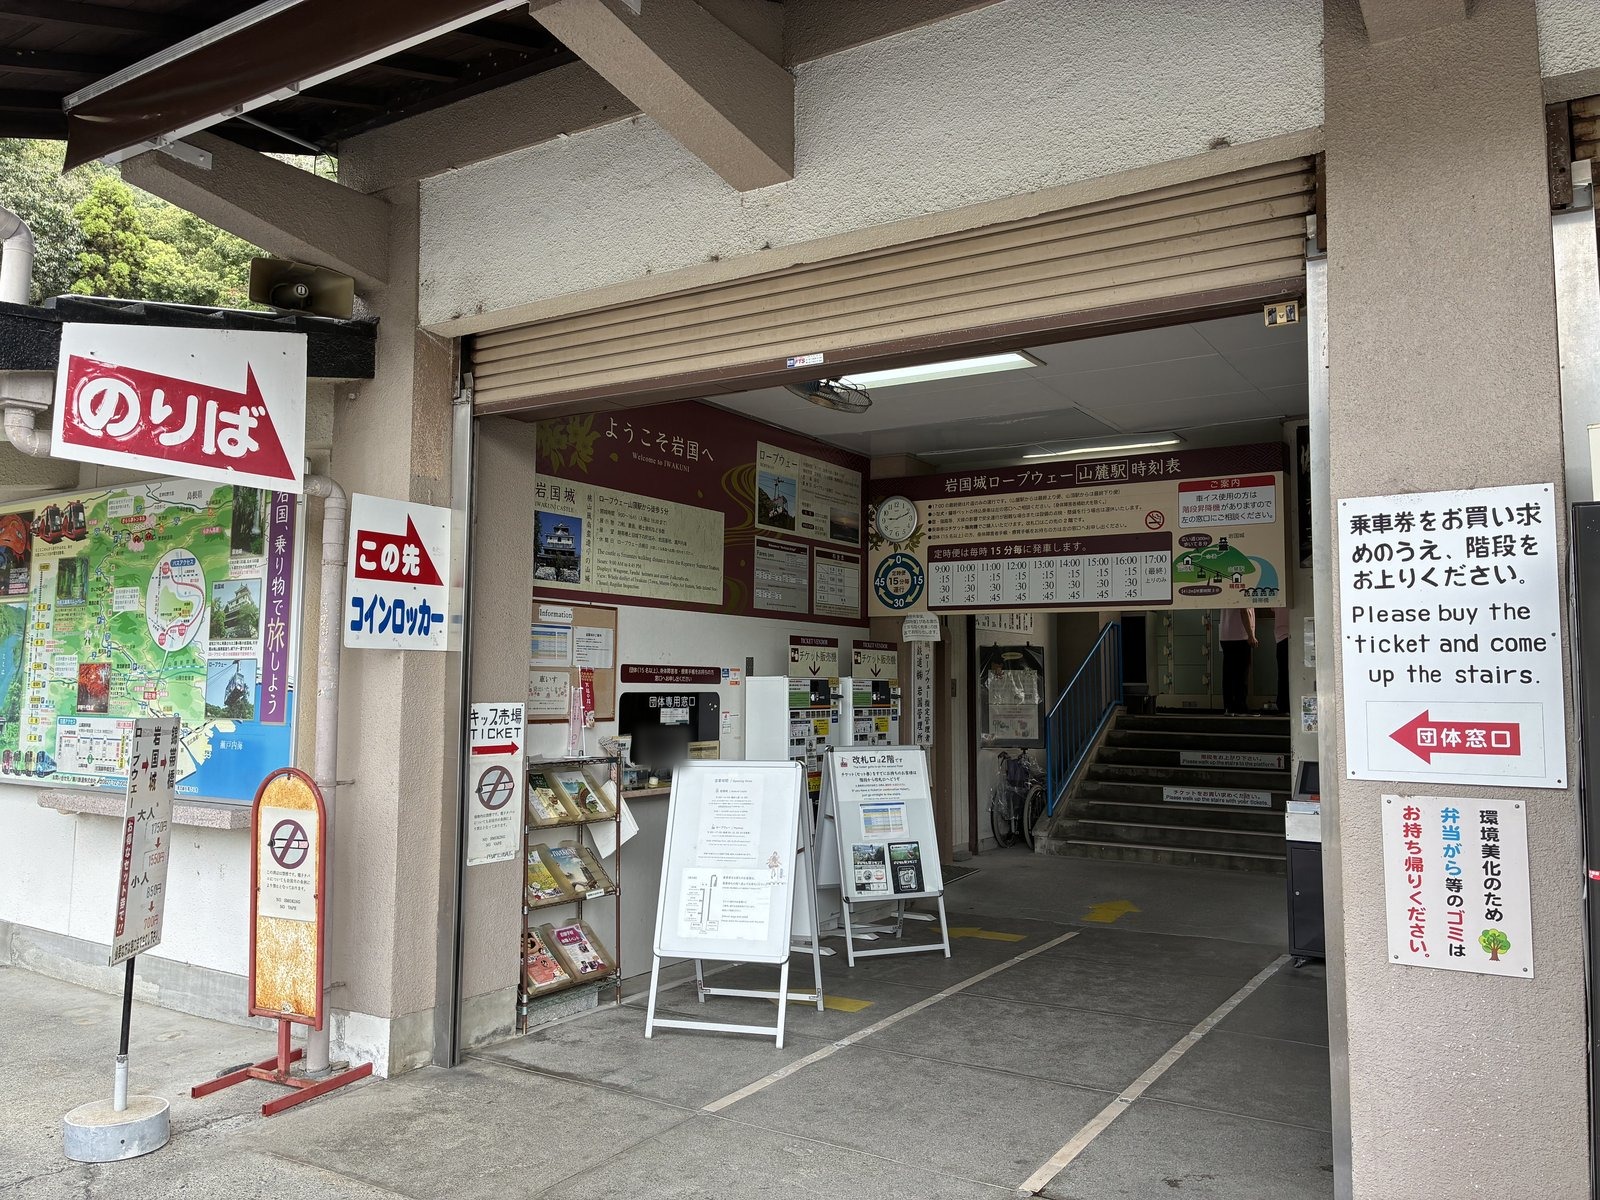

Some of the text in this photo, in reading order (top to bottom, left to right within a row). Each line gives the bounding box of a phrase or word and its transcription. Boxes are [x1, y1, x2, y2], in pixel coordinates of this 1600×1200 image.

[77, 377, 266, 458] のりば
[605, 417, 714, 462] ようこそ岩国へ
[632, 452, 657, 464] Welcome
[664, 461, 690, 472] IWAKUNI
[760, 450, 798, 468] ロープウェー
[944, 458, 1181, 493] 岩国城ロープウェー 山麓駅 時刻表
[1210, 479, 1240, 488] ご案内
[535, 482, 576, 504] 岩国城
[1196, 491, 1257, 502] 車イス使用の方は
[1182, 501, 1272, 514] 階段昇降機がありますので
[1182, 510, 1274, 524] 左の窓口にご相談ください。
[1349, 502, 1542, 536] 乗車券をお買い求
[934, 543, 1087, 559] 定時便は毎時 15 分毎に発車します。
[1352, 534, 1540, 563] めのうえ、階段を
[359, 540, 420, 576] この先
[896, 556, 902, 564] 0
[935, 554, 1167, 573] 9:00 10:00 11:00 12:00 13:00 14:00 15:00 16:00 17:00
[939, 567, 1137, 583] :15 :15 :15 :15 :15 :15 :15 :15
[1145, 567, 1167, 576] (最終)
[1352, 565, 1526, 591] お上りください。
[875, 578, 885, 587] 45
[913, 576, 923, 584] 15
[939, 578, 1137, 593] :30 :30 :30 :30 :30 :30 :30 :30
[894, 599, 904, 607] 30
[939, 589, 1137, 603] :45 :45 :45 :45 :45 :45 :45 :45
[350, 594, 444, 637] コインロッカー
[539, 608, 572, 619] Information
[1352, 602, 1531, 626] Please buy the
[1354, 634, 1548, 654] ticket and come
[1369, 664, 1541, 687] up the stairs.
[649, 696, 695, 708] 団体専用窓口
[470, 708, 522, 728] キップ売場
[471, 727, 521, 740] TICKET
[1417, 727, 1511, 749] 団体窓口
[220, 740, 243, 750] 瀬戸内海
[148, 726, 162, 791] 岩国城
[167, 726, 178, 789] 錦帯橋
[852, 755, 903, 764] 改札口は2階です
[1173, 790, 1260, 799] チケットをお買い求めください。
[137, 806, 155, 821] 大人
[151, 820, 167, 834] 1750円
[148, 851, 165, 867] 1550円
[1480, 810, 1504, 923] 環境美化のため
[131, 872, 149, 888] 小人
[1402, 806, 1431, 959] お持ち帰りください。
[1440, 807, 1466, 958] 弁当がら等のゴミは
[146, 883, 161, 898] 850円
[144, 915, 159, 929] 700円
